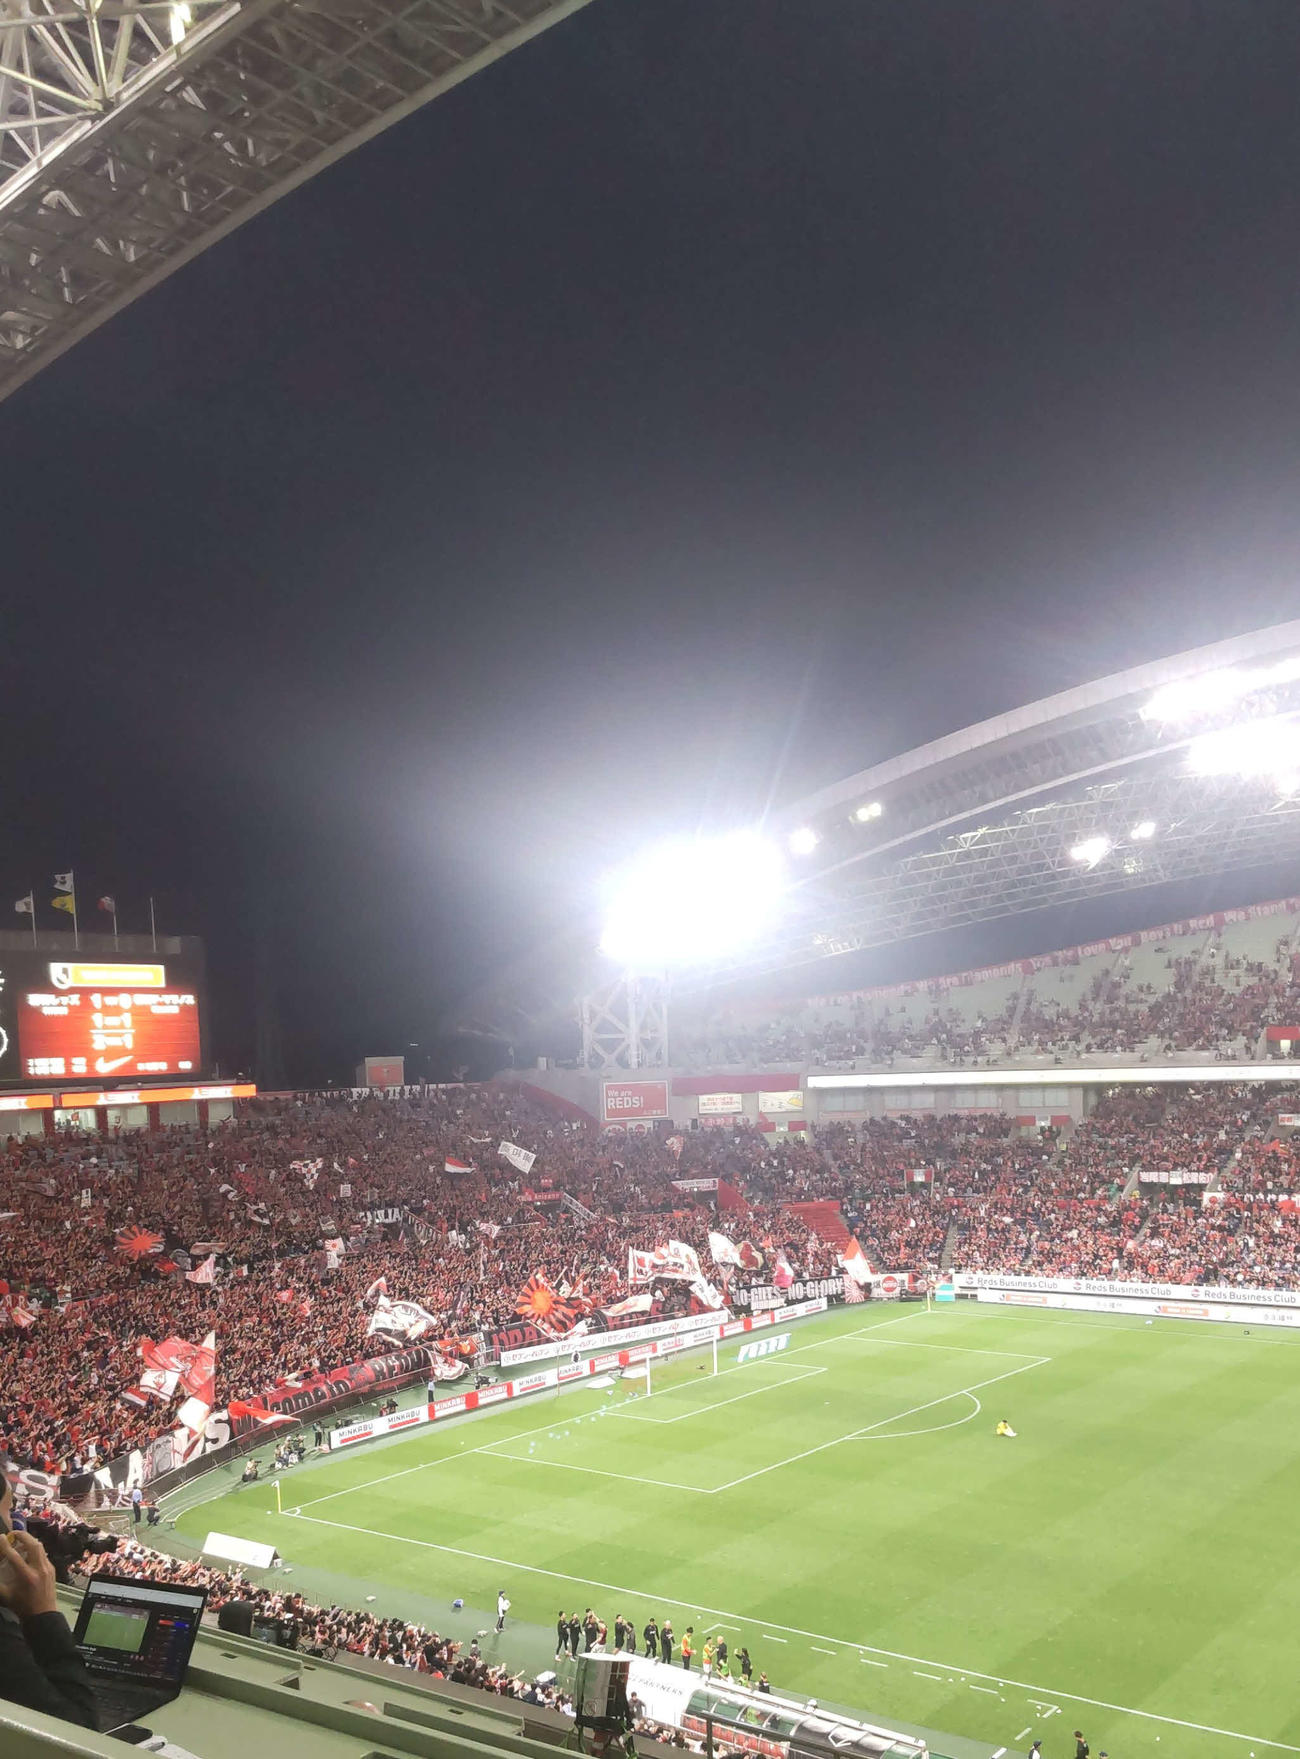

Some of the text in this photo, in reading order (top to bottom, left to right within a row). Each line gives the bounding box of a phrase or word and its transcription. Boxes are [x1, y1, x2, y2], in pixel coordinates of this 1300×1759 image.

[607, 1089, 619, 1097] We
[607, 1096, 644, 1110] REDS!
[999, 1279, 1037, 1289] Business
[1038, 1281, 1058, 1290] Club
[1085, 1282, 1172, 1297] Reds Business Club
[1204, 1289, 1297, 1305] Reds Business Club
[387, 1409, 421, 1423] MINKABU
[338, 1423, 374, 1438] MINKABU
